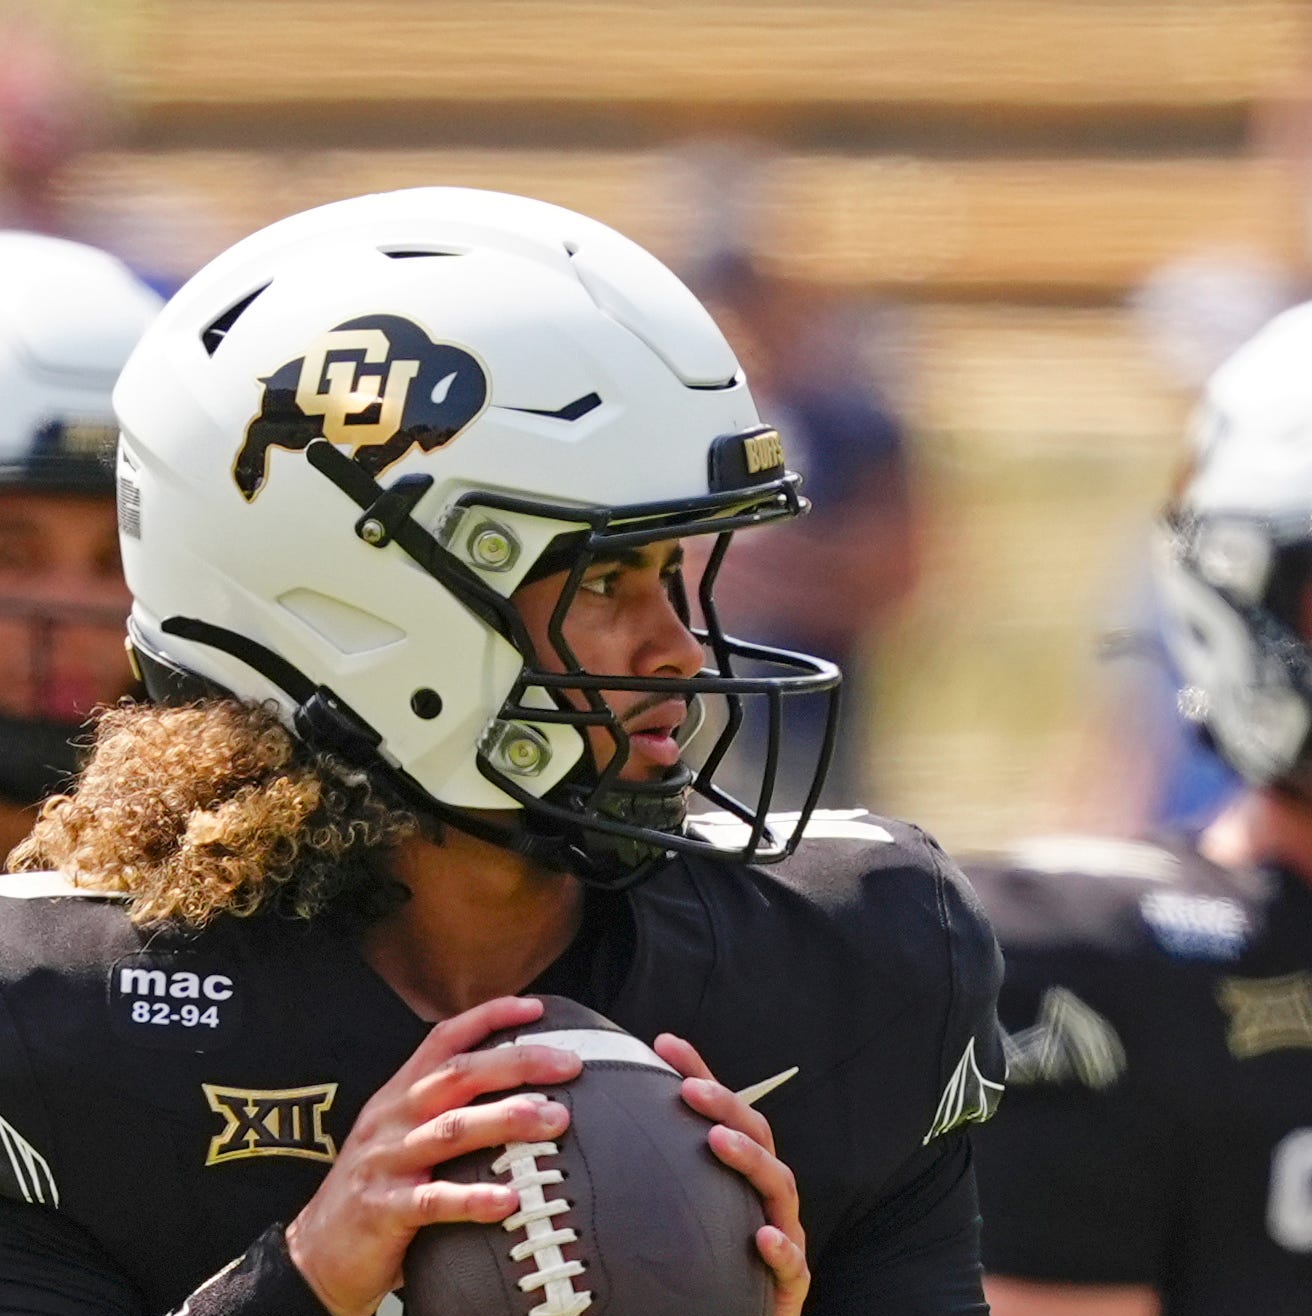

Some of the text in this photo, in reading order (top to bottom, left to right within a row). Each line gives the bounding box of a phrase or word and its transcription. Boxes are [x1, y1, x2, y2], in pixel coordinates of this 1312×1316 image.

[295, 329, 420, 445] CU
[743, 430, 785, 474] BUFFS
[119, 967, 234, 1001] mac
[131, 1001, 220, 1029] 82-94
[207, 1086, 334, 1161] XII
